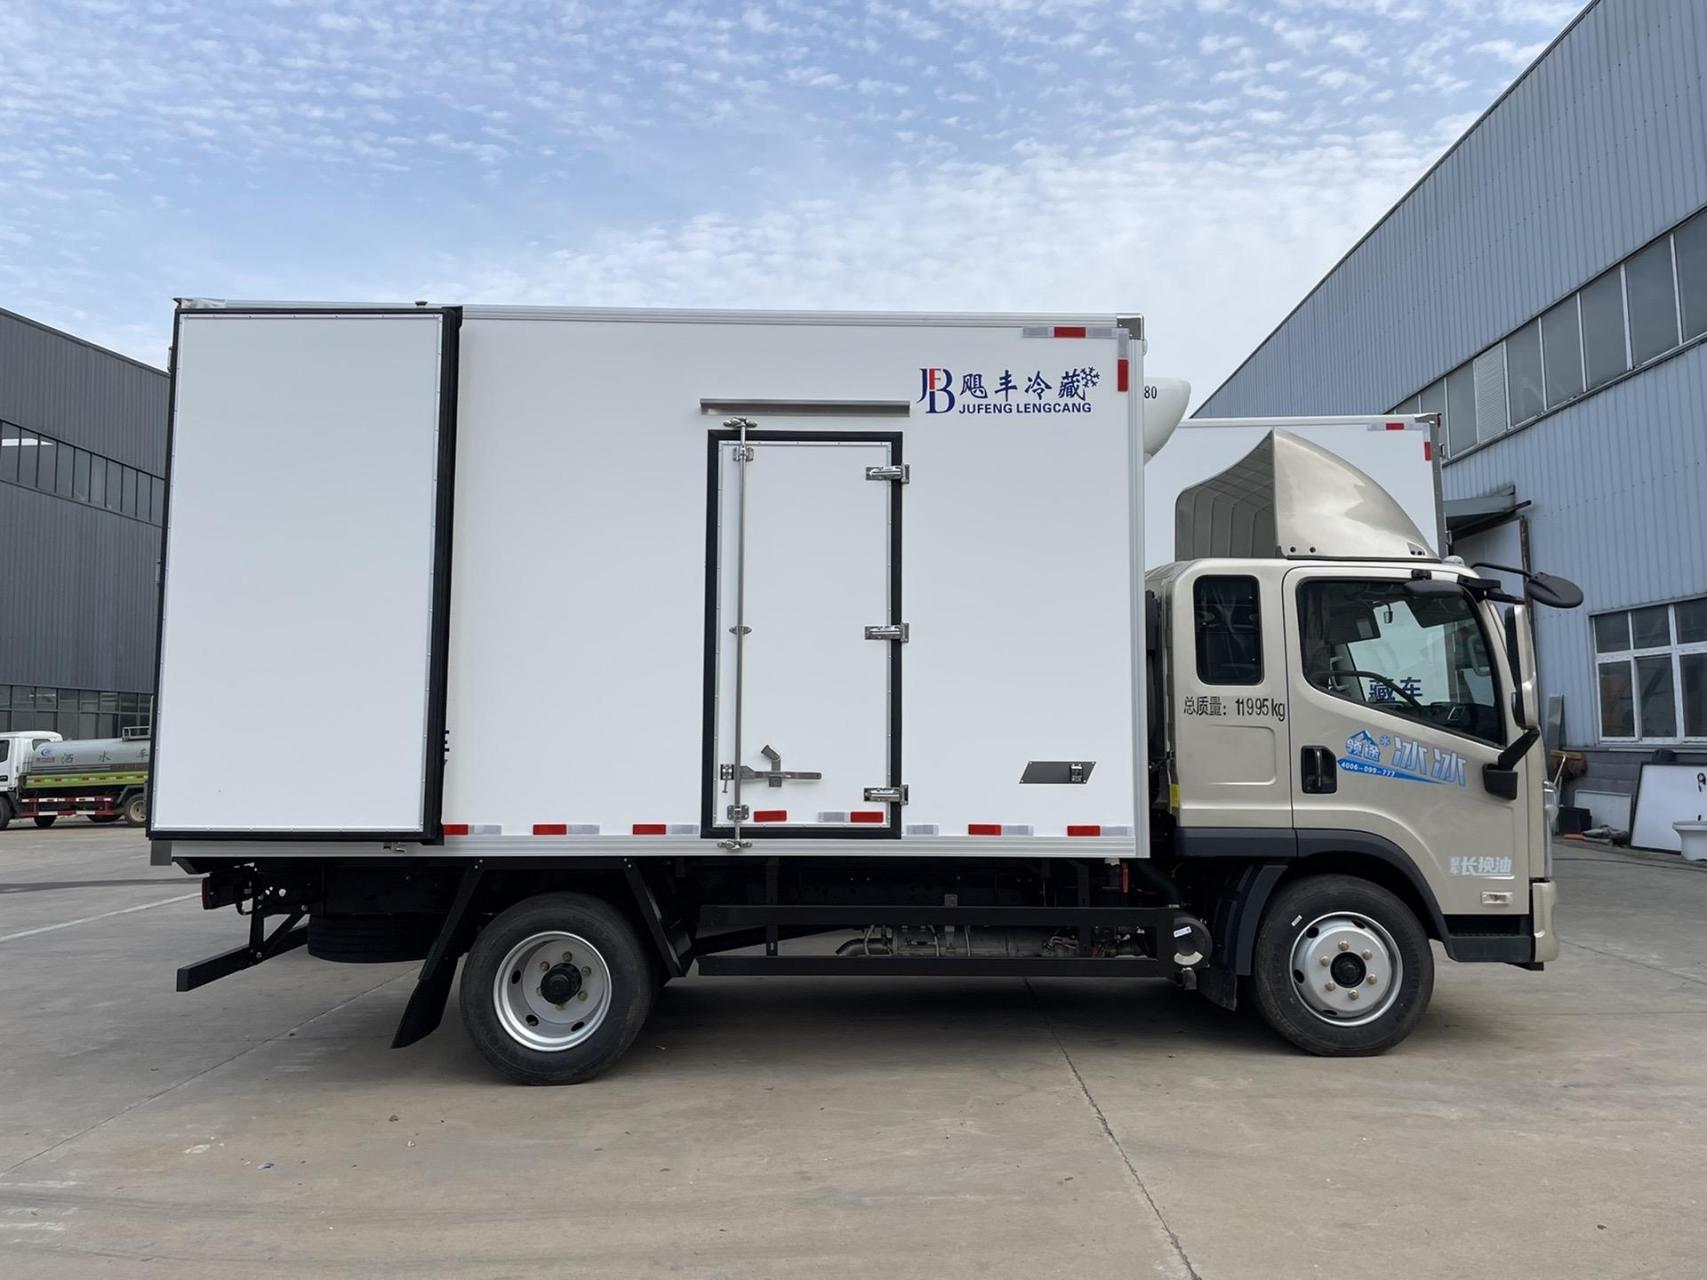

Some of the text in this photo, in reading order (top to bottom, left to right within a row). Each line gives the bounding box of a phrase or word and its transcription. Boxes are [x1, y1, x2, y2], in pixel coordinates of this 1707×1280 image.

[959, 369, 1087, 401] 飓丰冷藏
[959, 402, 1092, 414] JUFENG LENGCANG
